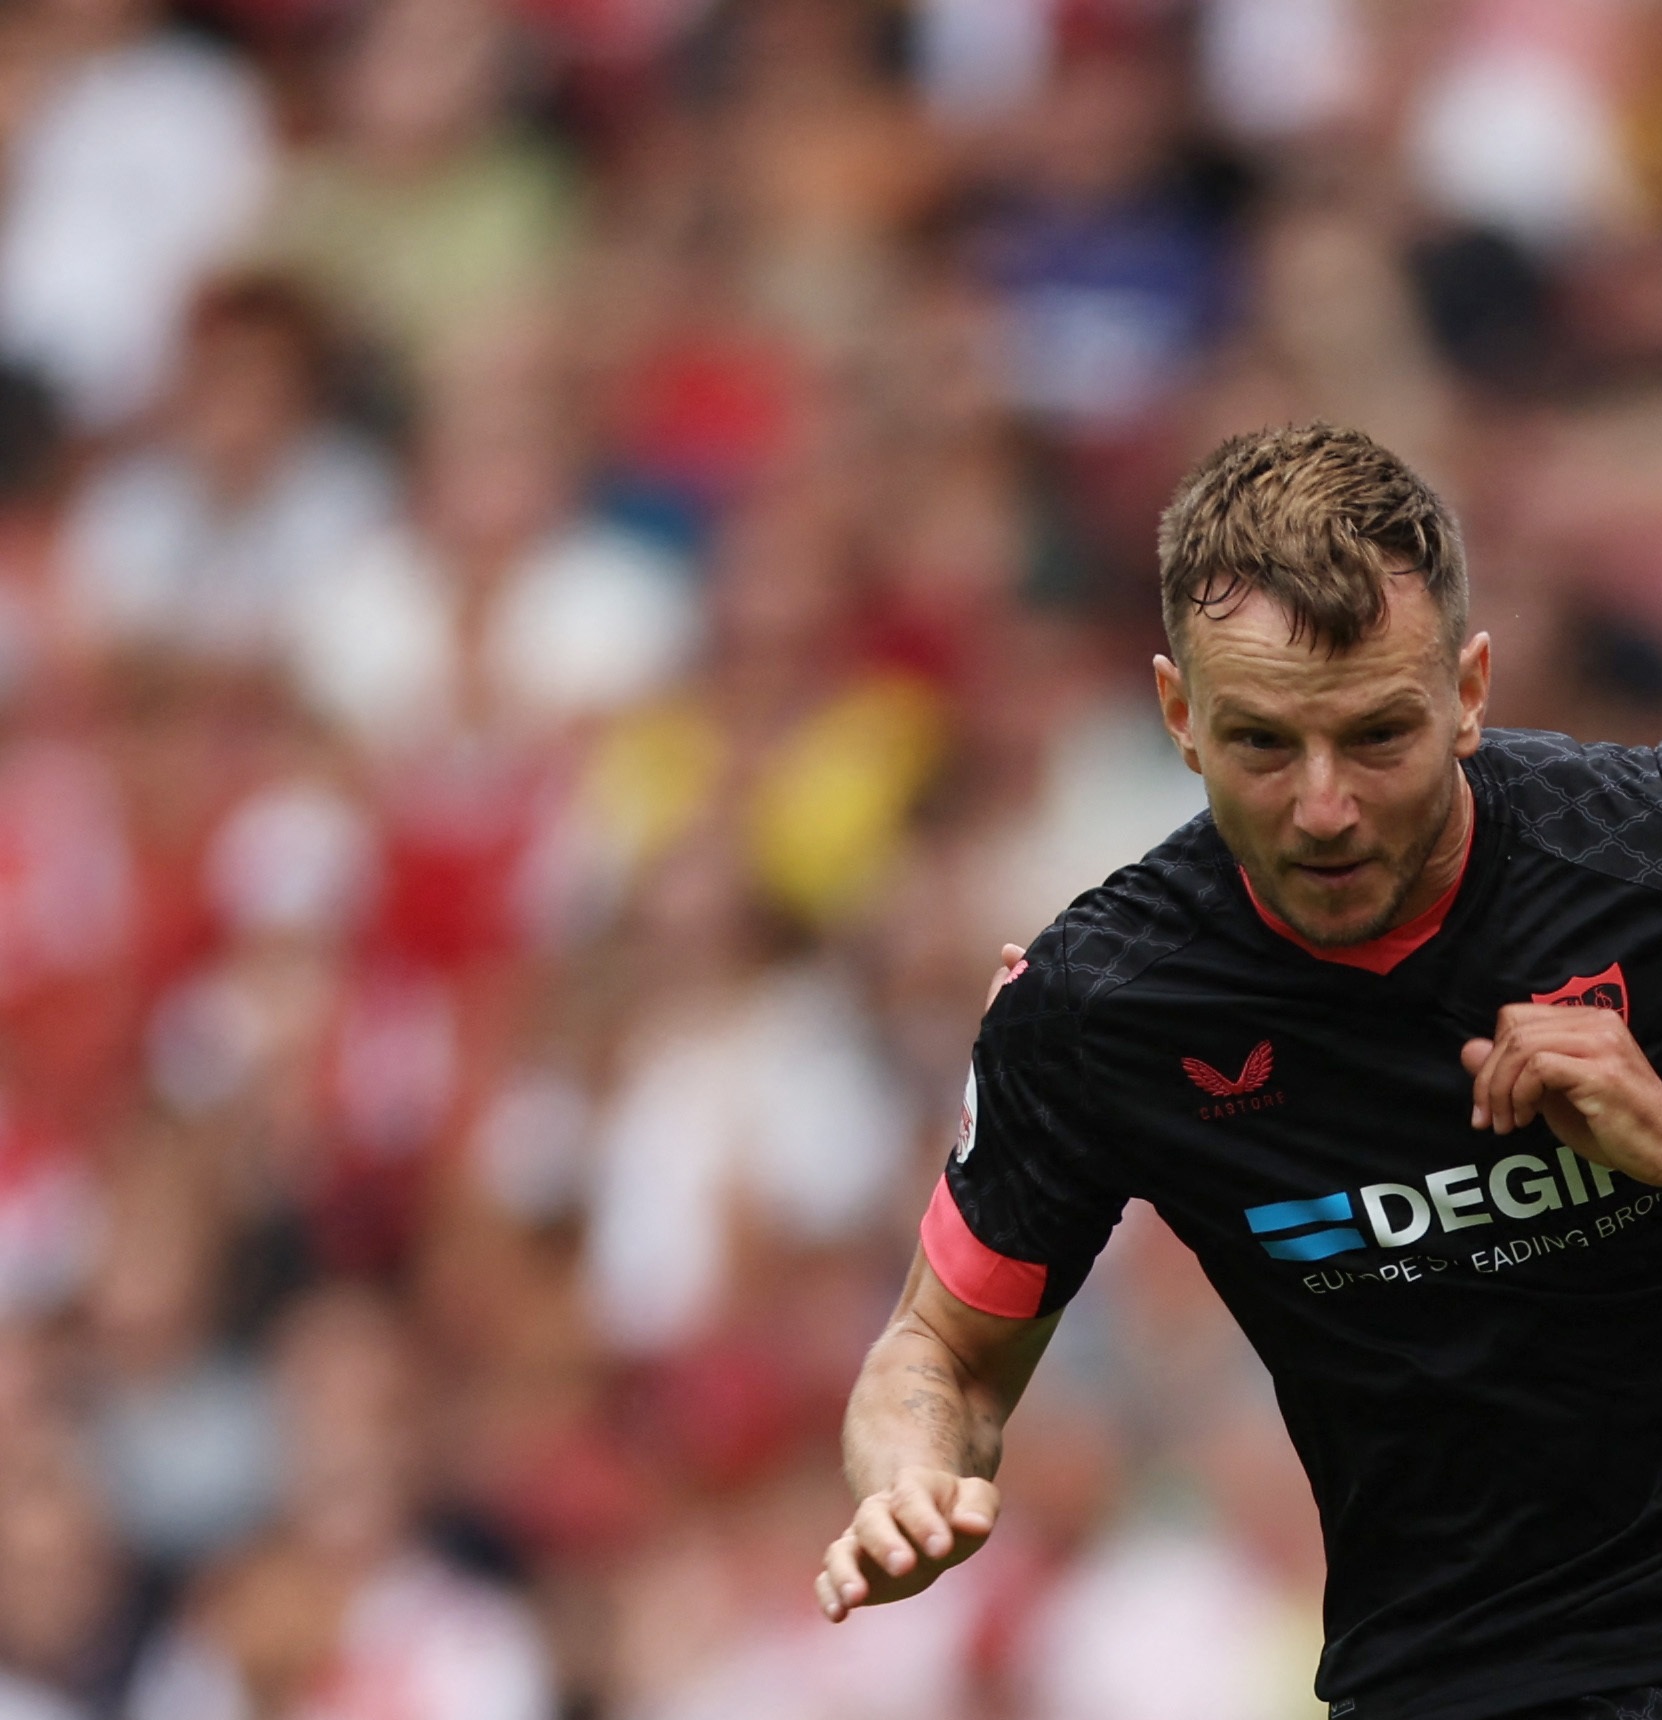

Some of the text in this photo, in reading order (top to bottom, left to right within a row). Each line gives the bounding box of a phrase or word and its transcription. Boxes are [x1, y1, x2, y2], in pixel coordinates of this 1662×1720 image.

[1200, 1091, 1286, 1120] CASTORE
[1360, 1146, 1620, 1249] DEGI
[1454, 1227, 1590, 1274] EADING
